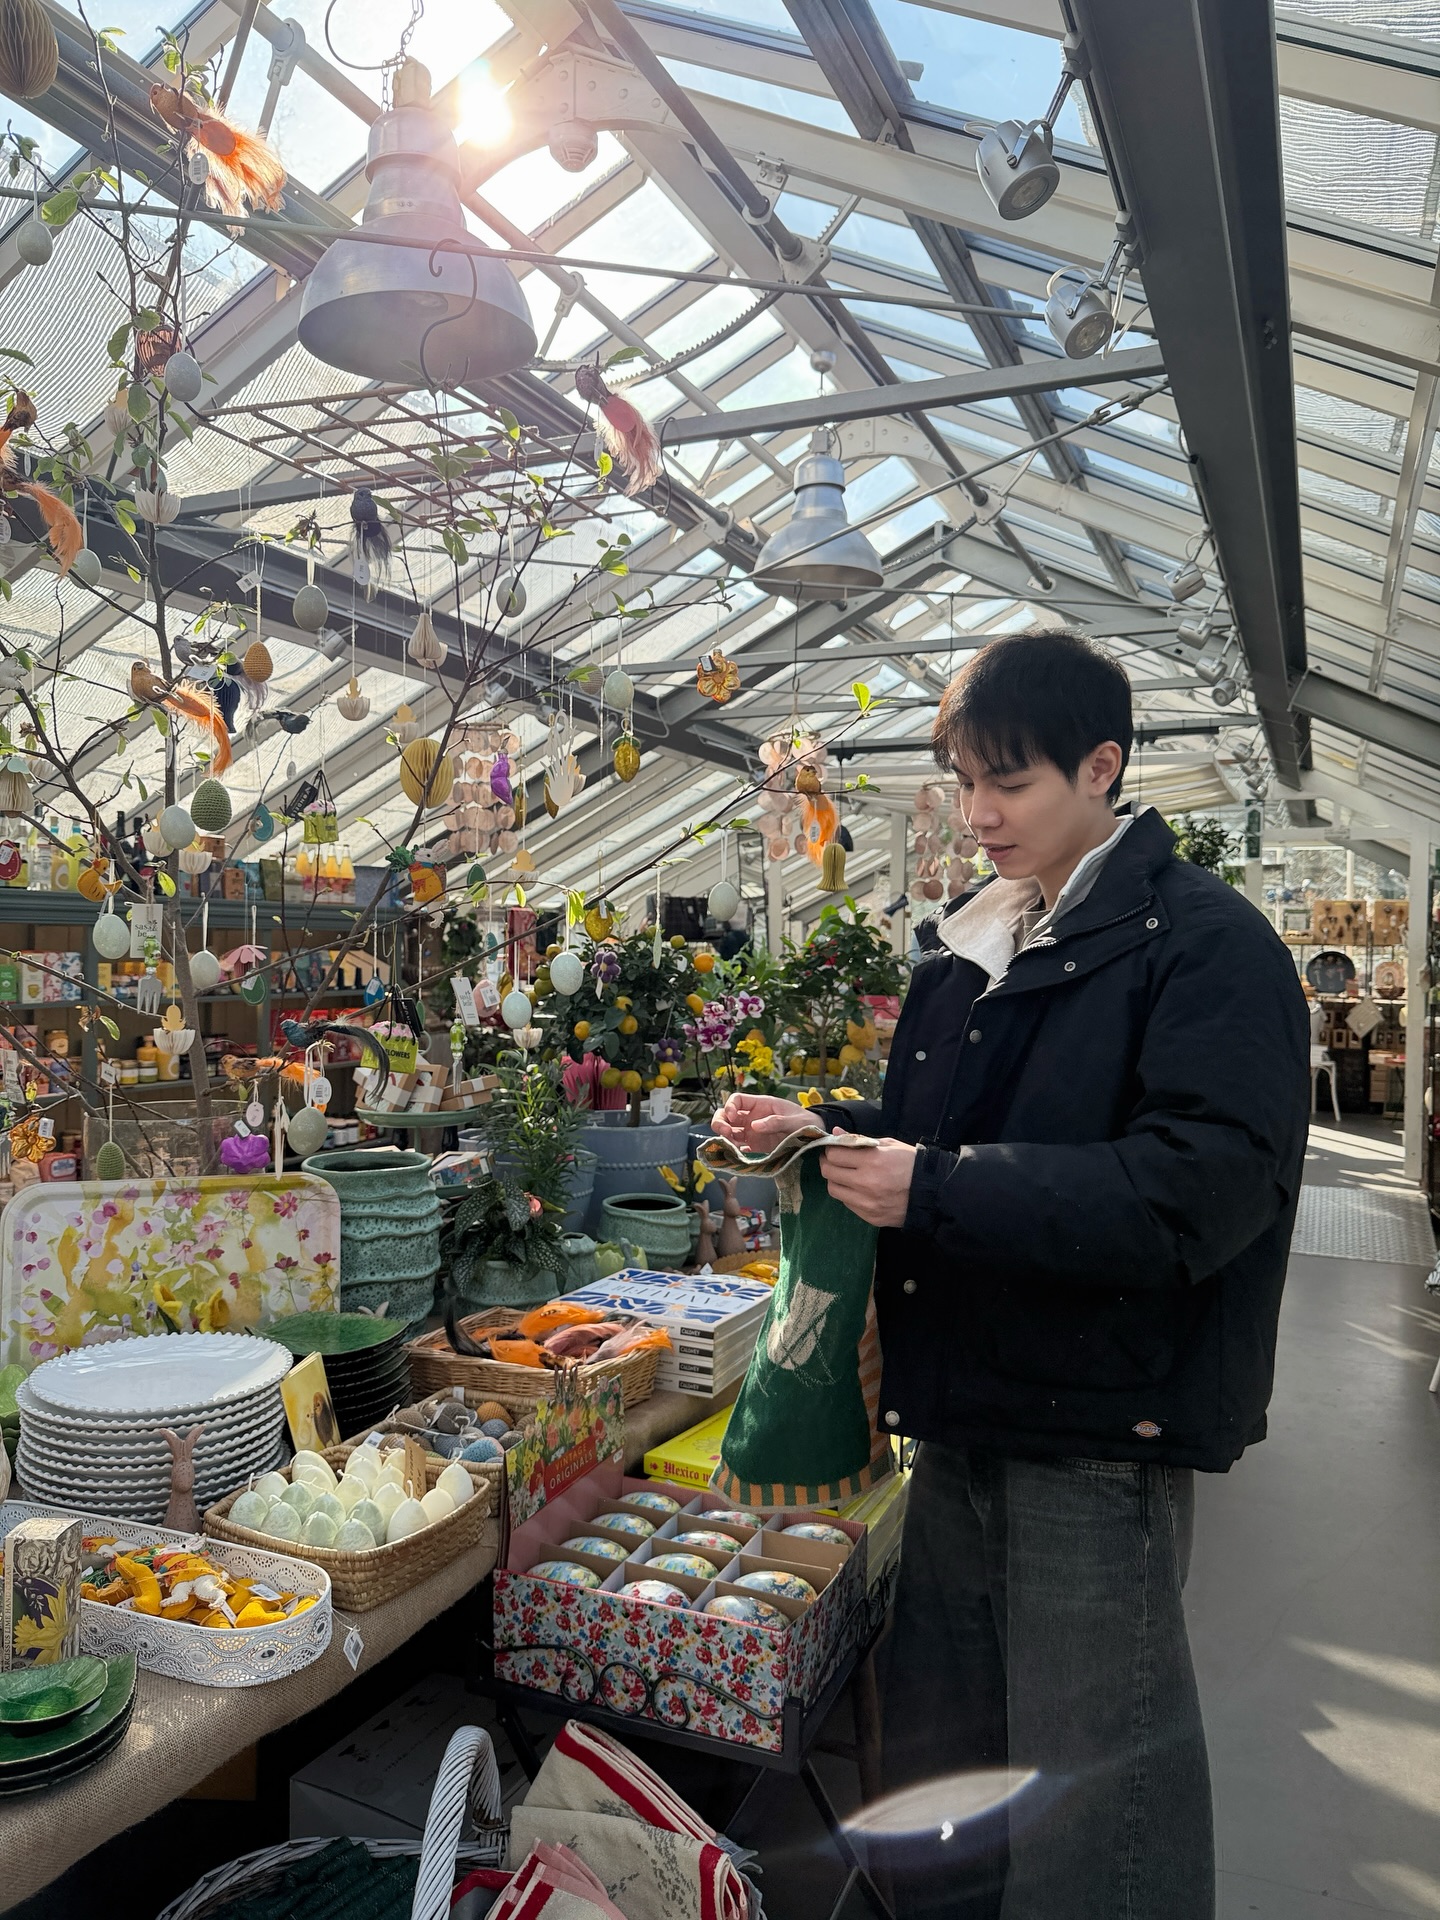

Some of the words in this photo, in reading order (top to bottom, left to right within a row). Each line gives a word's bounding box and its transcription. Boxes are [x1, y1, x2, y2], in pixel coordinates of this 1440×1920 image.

[549, 1450, 593, 1489] ORIGINALS
[555, 1442, 587, 1471] VINTAGE
[663, 1460, 699, 1480] Mexico
